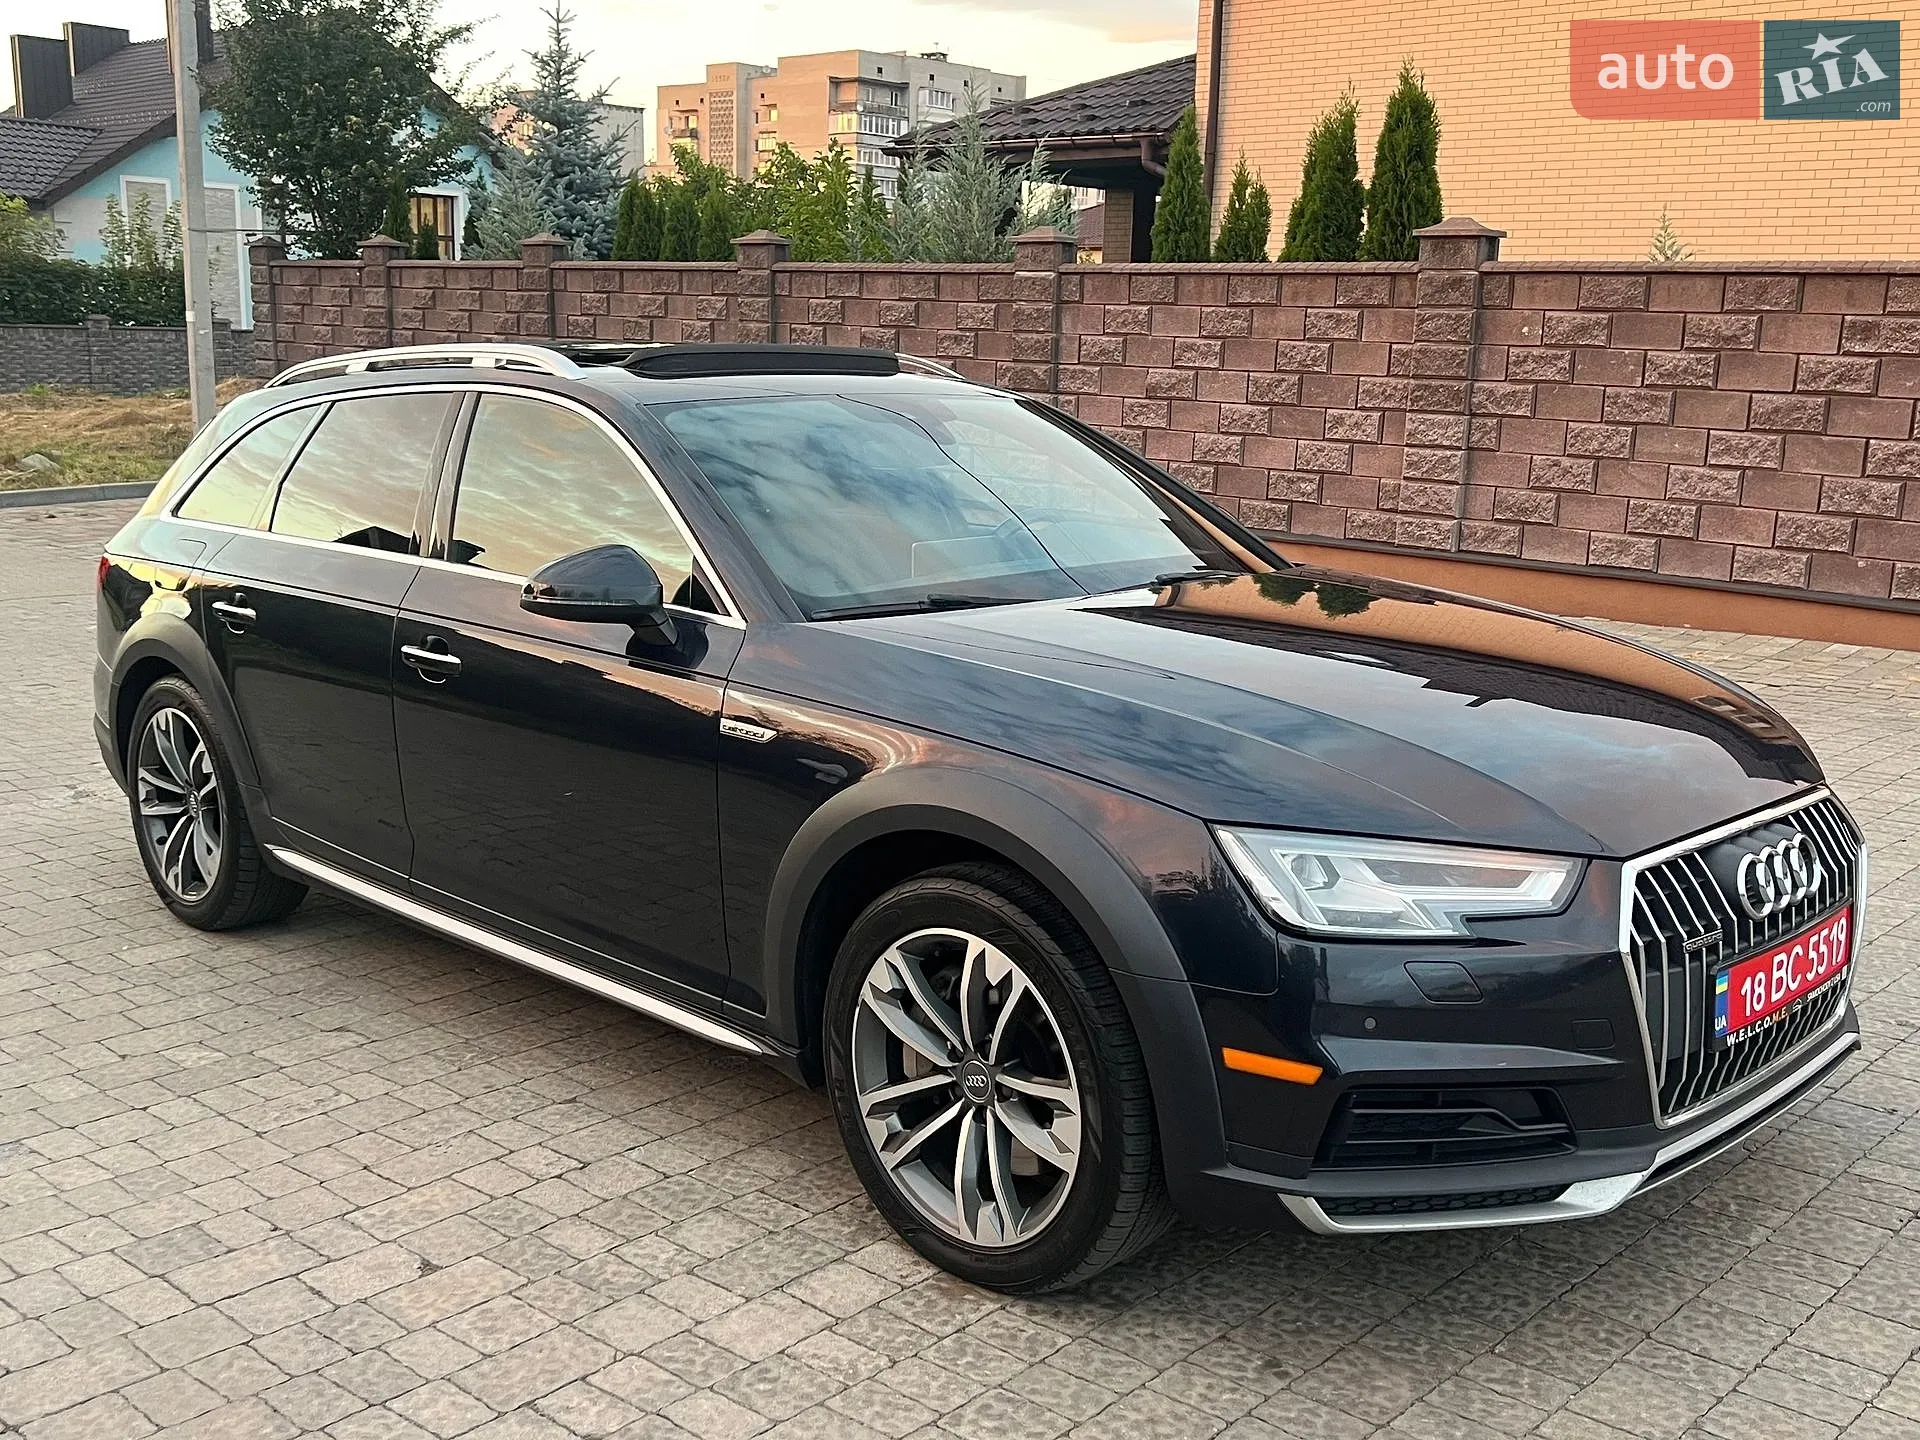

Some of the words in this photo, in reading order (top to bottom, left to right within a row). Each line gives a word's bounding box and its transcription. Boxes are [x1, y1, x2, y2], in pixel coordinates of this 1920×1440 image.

[1740, 971, 1767, 1017] 18
[1770, 944, 1804, 1003] BC
[1805, 916, 1847, 982] 5519
[1714, 1014, 1728, 1032] UA
